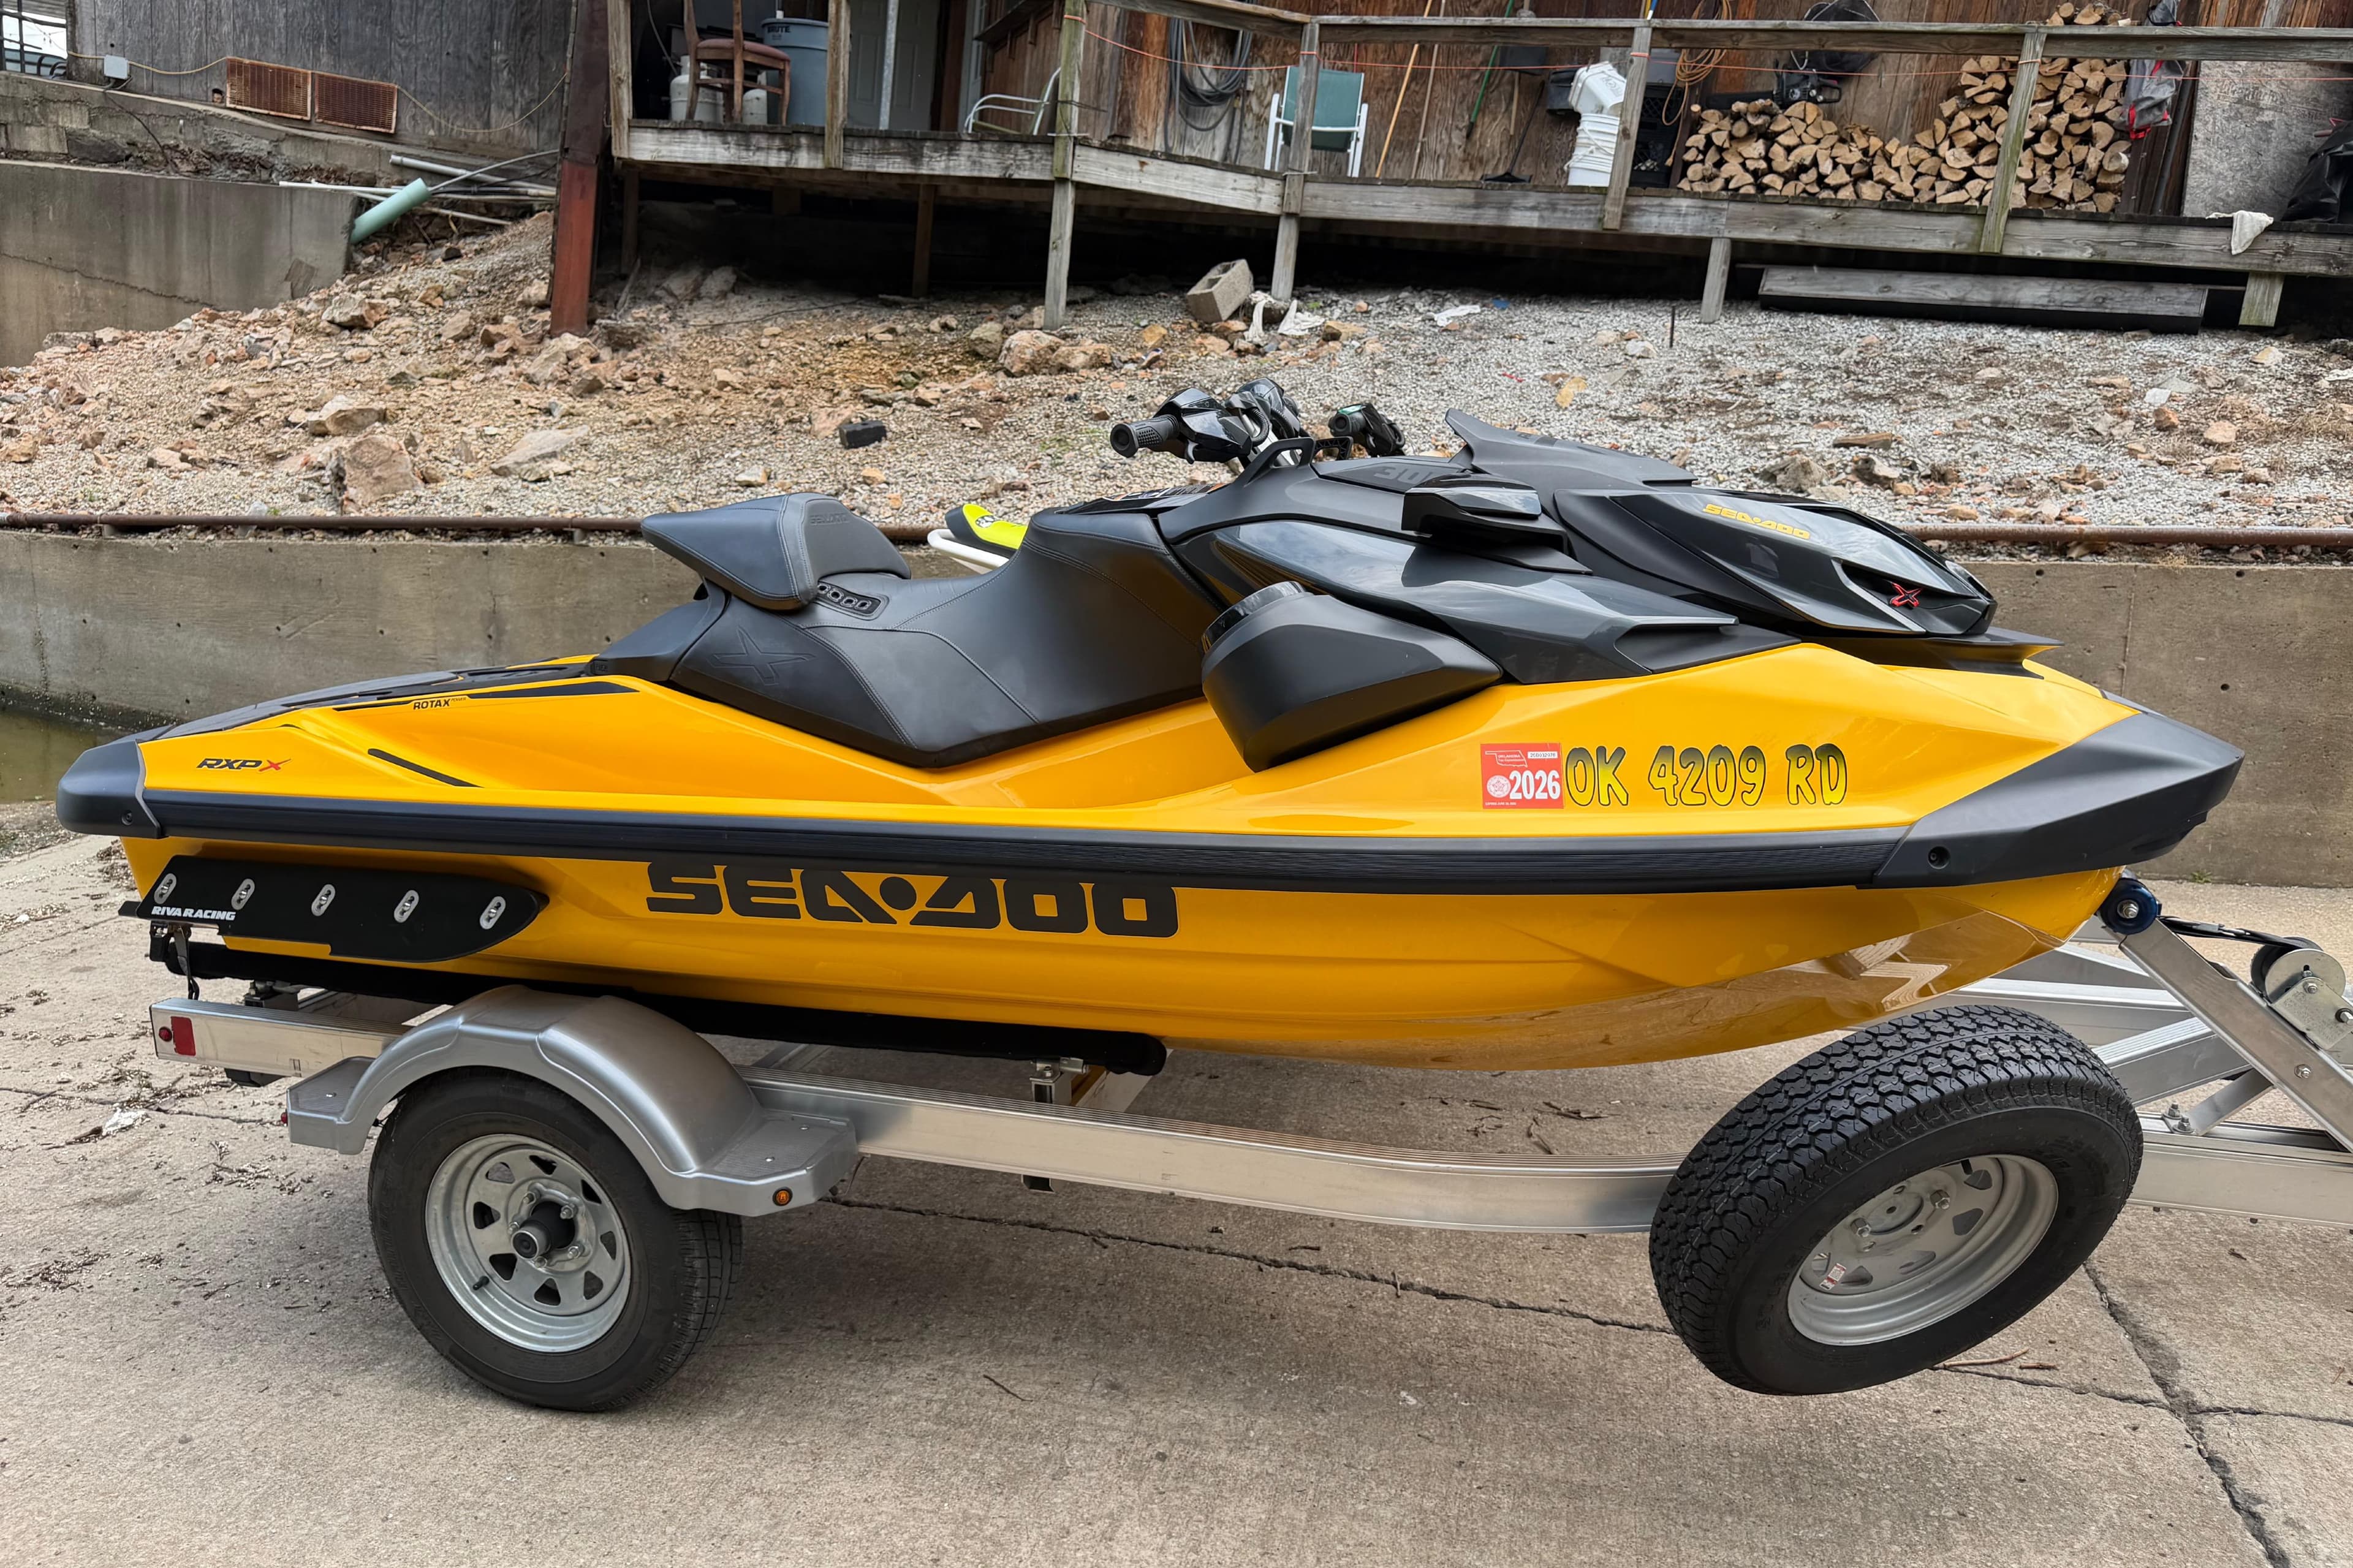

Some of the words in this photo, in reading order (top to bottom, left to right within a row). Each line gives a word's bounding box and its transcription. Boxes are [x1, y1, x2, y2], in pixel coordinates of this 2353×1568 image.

[413, 699, 451, 710] ROTAX
[1509, 770, 1561, 800] 2026
[1566, 746, 1629, 806] OK
[1648, 744, 1766, 806] 4209
[1785, 743, 1847, 806] RD
[151, 906, 182, 917] RIVA
[183, 908, 237, 921] RACING
